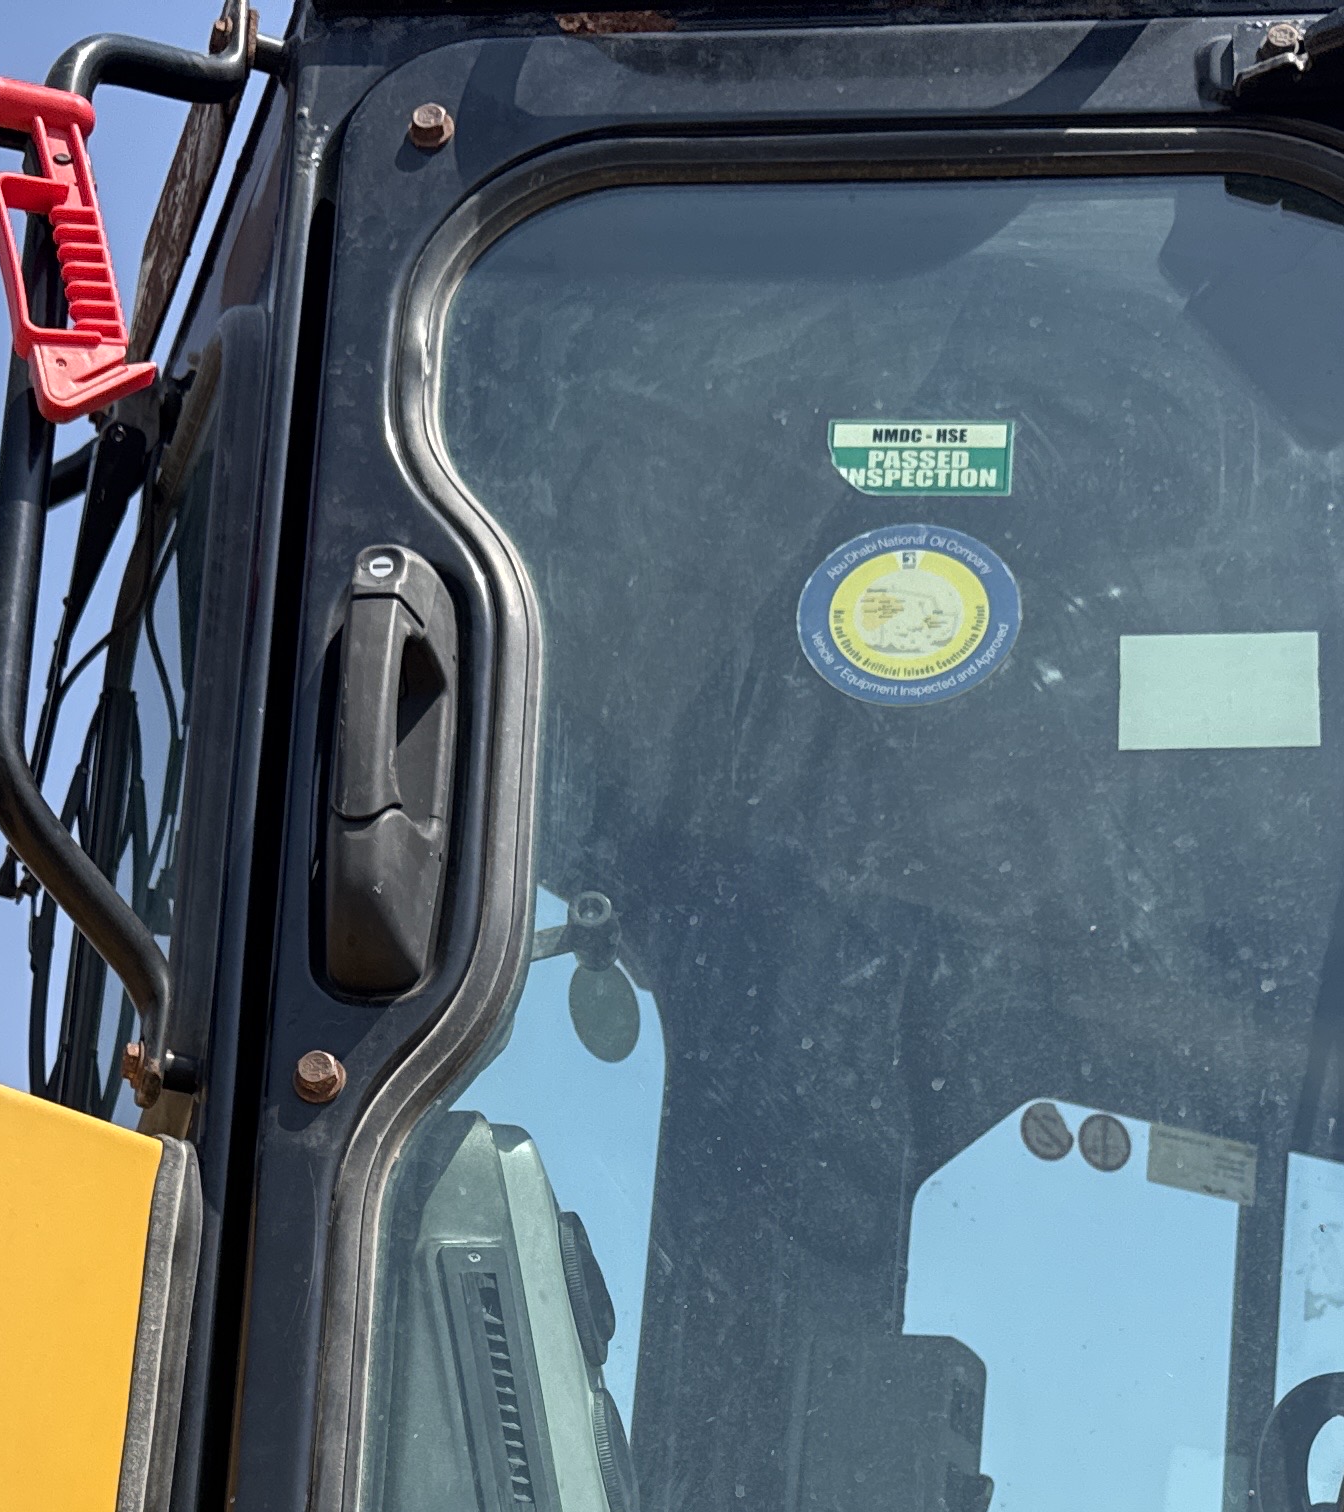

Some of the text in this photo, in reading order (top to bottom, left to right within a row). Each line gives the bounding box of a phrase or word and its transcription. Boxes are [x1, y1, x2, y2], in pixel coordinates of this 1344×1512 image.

[872, 428, 922, 442] NMDC
[936, 428, 968, 442] HSE
[868, 450, 970, 469] PASSED
[826, 535, 993, 581] Abu Dhabi National Oil Company
[811, 631, 834, 665] Vehicle
[840, 668, 897, 696] Equipment
[900, 678, 957, 696] Inspected
[958, 667, 977, 682] and
[974, 623, 1009, 670] Approved
[903, 666, 935, 677] Islands
